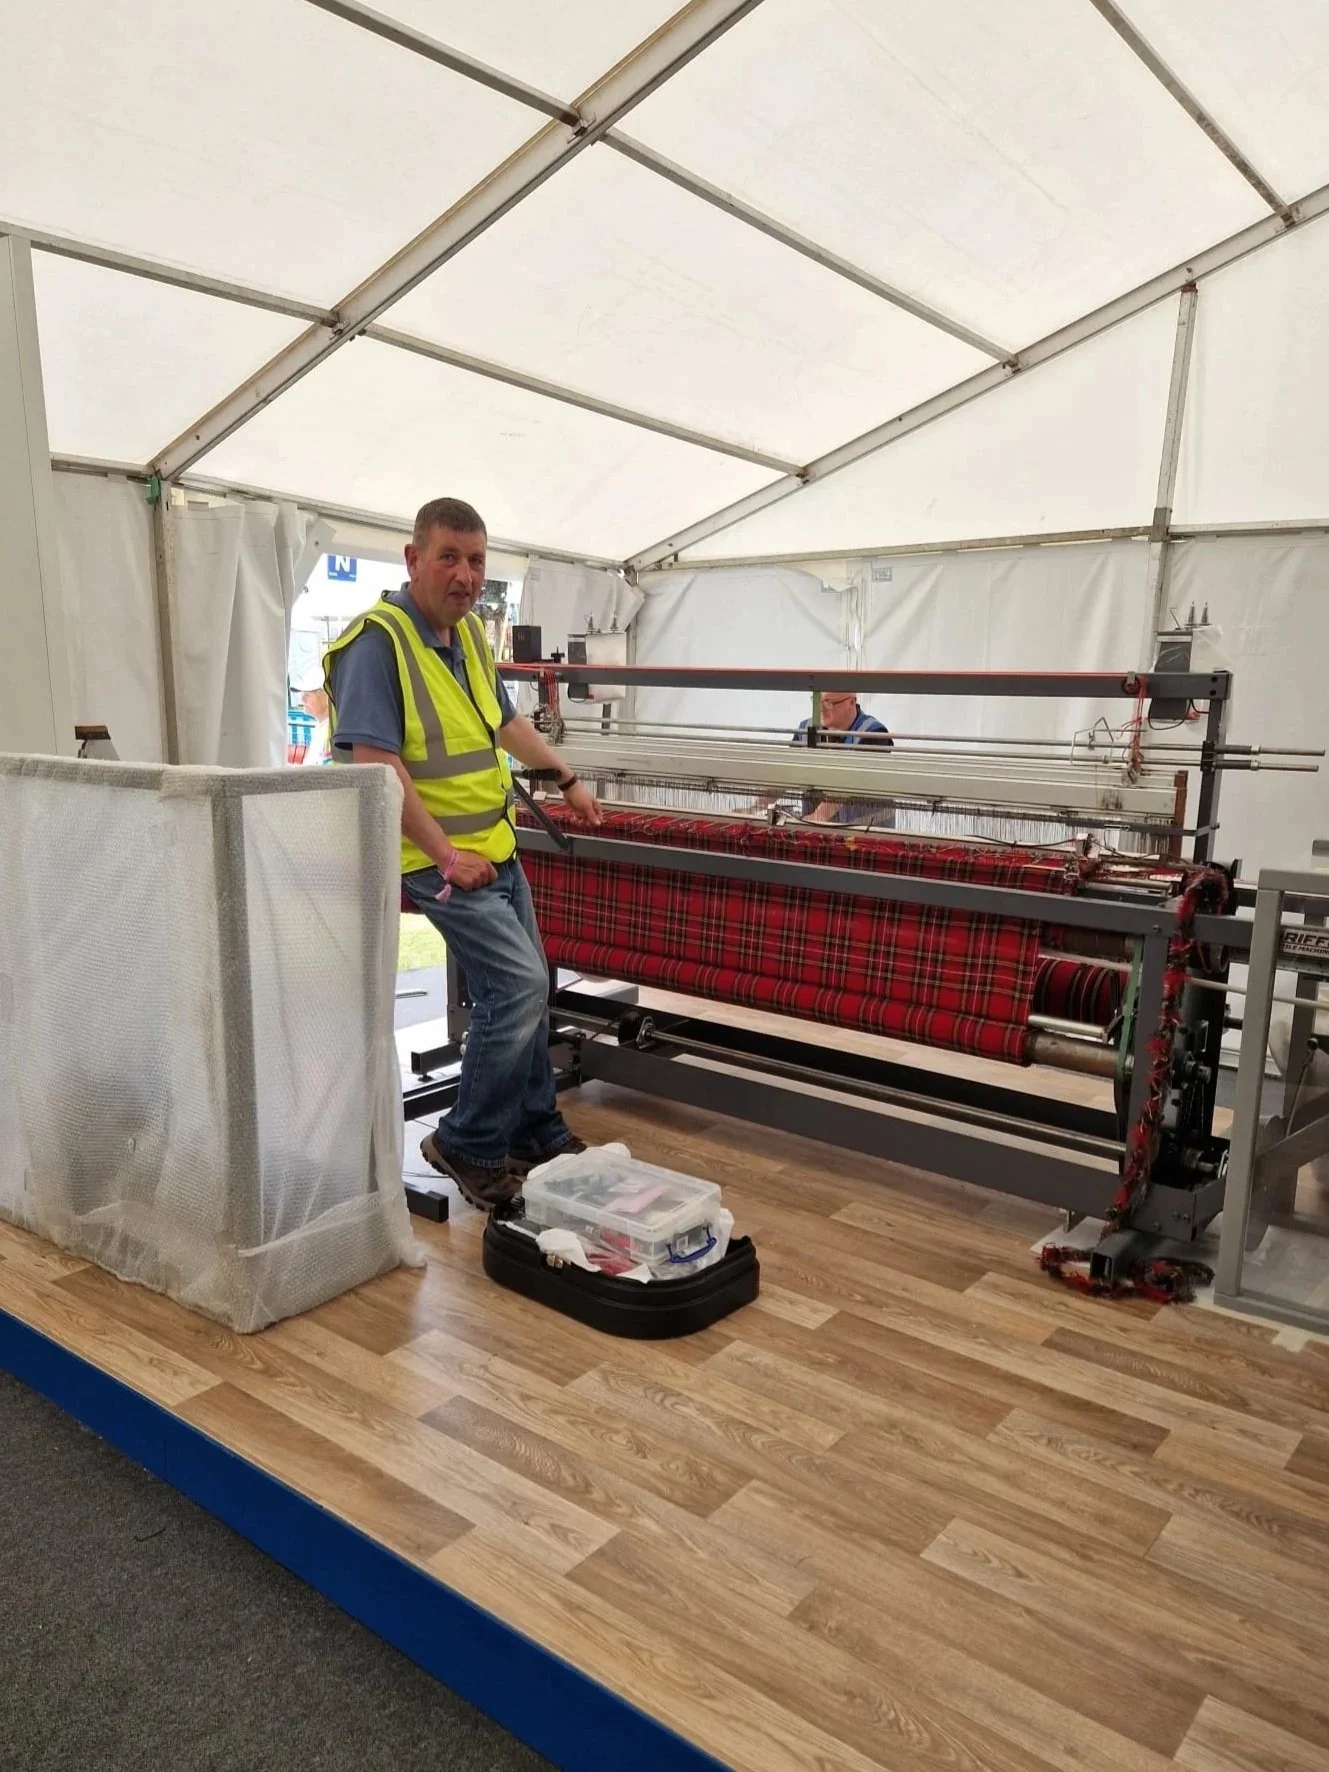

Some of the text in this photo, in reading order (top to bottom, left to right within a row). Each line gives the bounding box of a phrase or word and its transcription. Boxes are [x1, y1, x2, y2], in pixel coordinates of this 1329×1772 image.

[335, 555, 351, 573] N
[1282, 931, 1329, 946] RIFF
[1298, 945, 1329, 954] MACHIN
